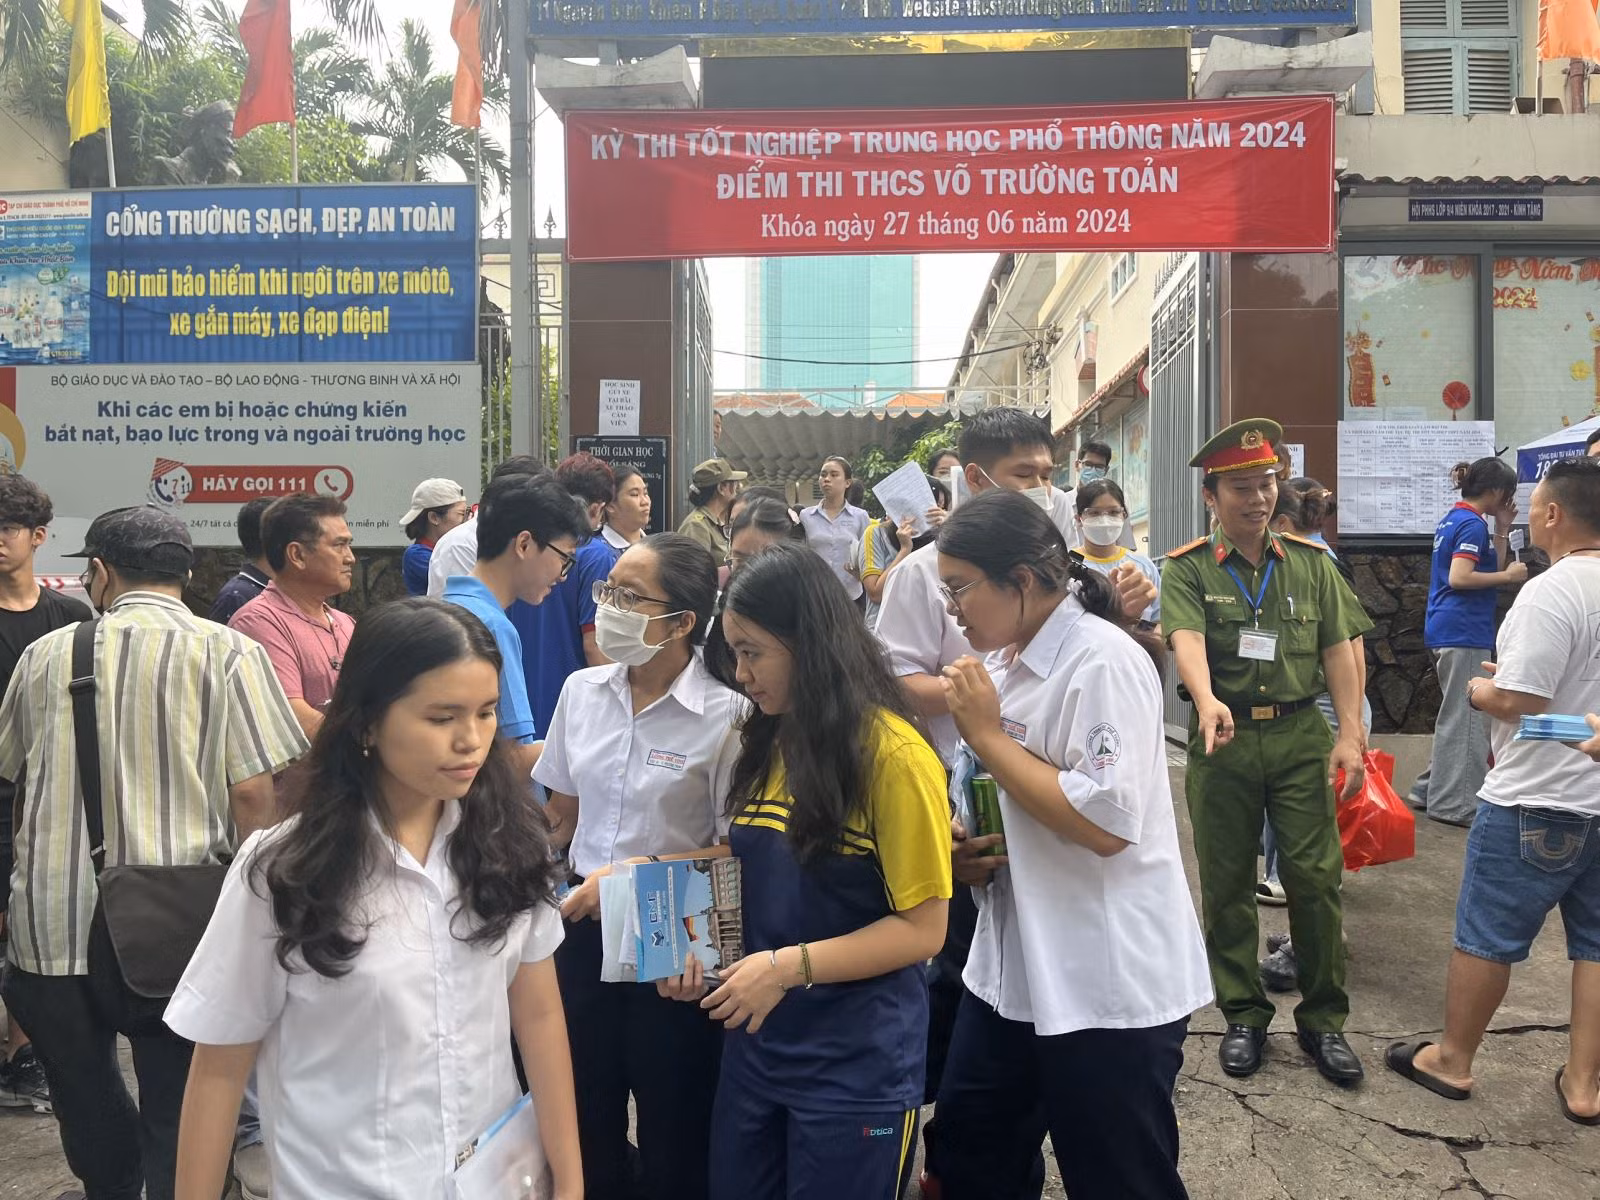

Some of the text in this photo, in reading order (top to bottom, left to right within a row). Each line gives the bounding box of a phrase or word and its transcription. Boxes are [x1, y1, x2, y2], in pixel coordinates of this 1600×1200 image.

[591, 118, 1306, 160] KỲ THI TỐT NGHIỆP TRUNG HỌC PHỔ THÔNG NĂM 2024
[716, 156, 1178, 200] ĐIỂM THI THCS VÕ TRƯỜNG TOẢN
[106, 201, 455, 239] CỔNG TRƯỜNG SẠCH, ĐẸP, AN TOÀN
[761, 208, 1131, 241] Khóa ngày 27 tháng 06 năm 2024
[107, 263, 454, 303] Đội mũ bảo hiểm khi ngồi trên xe môtô,
[170, 304, 389, 341] xe gắn máy, xe đạp điện!
[51, 374, 68, 388] BỘ
[71, 374, 100, 385] GIÁO
[103, 375, 128, 387] DỤC
[132, 373, 147, 385] VÀ
[150, 373, 176, 385] ĐÀO
[179, 375, 203, 387] TẠO
[215, 373, 233, 387] BỘ
[236, 375, 260, 385] LAO
[264, 373, 299, 387] ĐỘNG
[311, 375, 366, 386] THƯƠNG
[370, 375, 399, 385] BINH
[402, 373, 418, 385] VÀ
[420, 373, 436, 385] XÃ
[439, 373, 461, 387] HỘI
[98, 400, 407, 421] Khi các em bị hoặc chứng kiến
[45, 423, 466, 445] bắt nạt, bạo lực trong và ngoài trường học
[589, 444, 654, 458] THỜI GIAN HỌC
[203, 474, 306, 494] HÃY GỌI 111
[190, 520, 208, 528] 24/7
[356, 519, 375, 528] miễn
